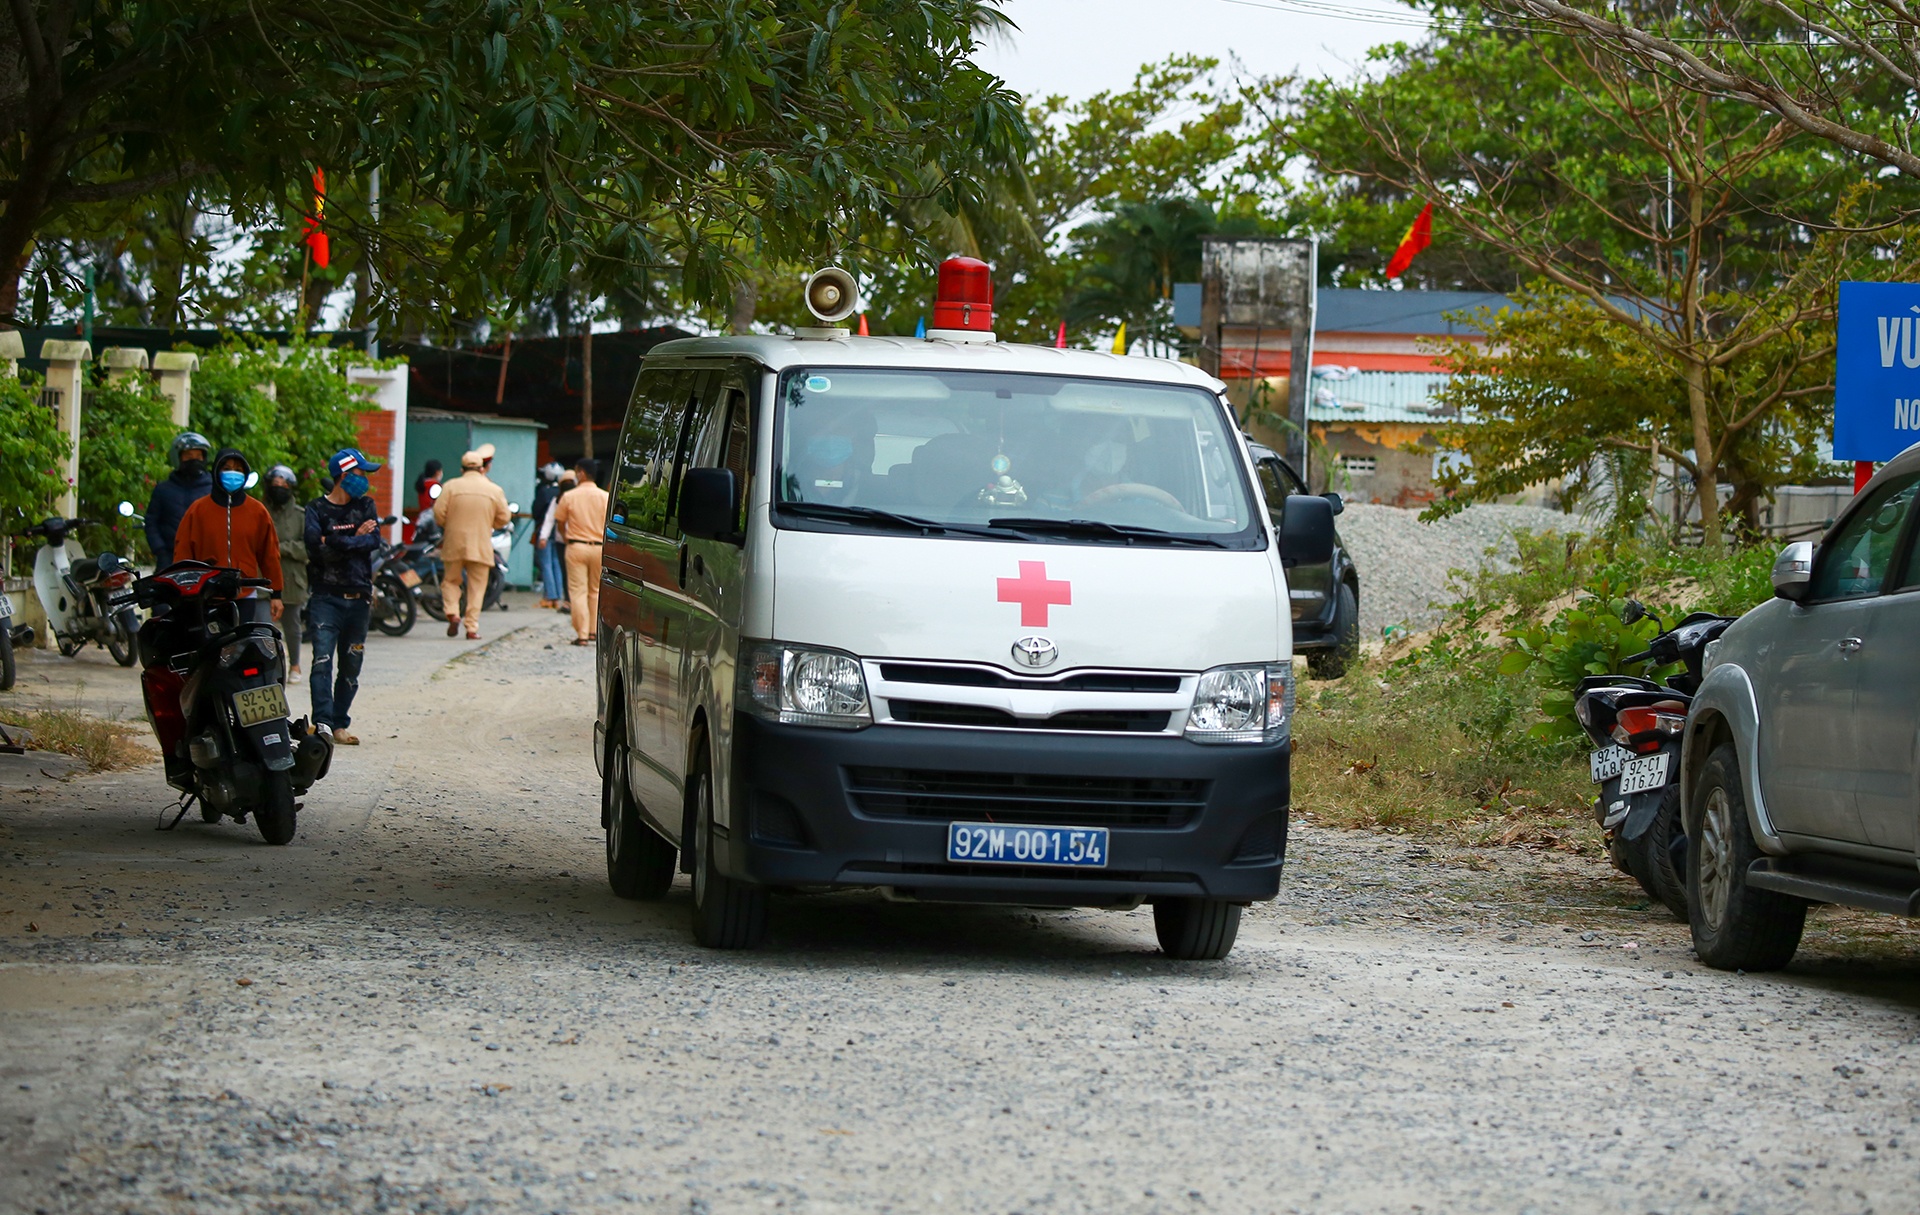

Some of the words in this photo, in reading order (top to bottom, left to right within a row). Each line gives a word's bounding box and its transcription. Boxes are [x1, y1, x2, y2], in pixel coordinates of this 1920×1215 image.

[241, 687, 277, 707] 92-C1
[242, 701, 287, 723] 112.94
[1629, 756, 1660, 776] 92-C1
[1623, 771, 1663, 792] 316.27
[955, 827, 1101, 863] 92M-001.54
